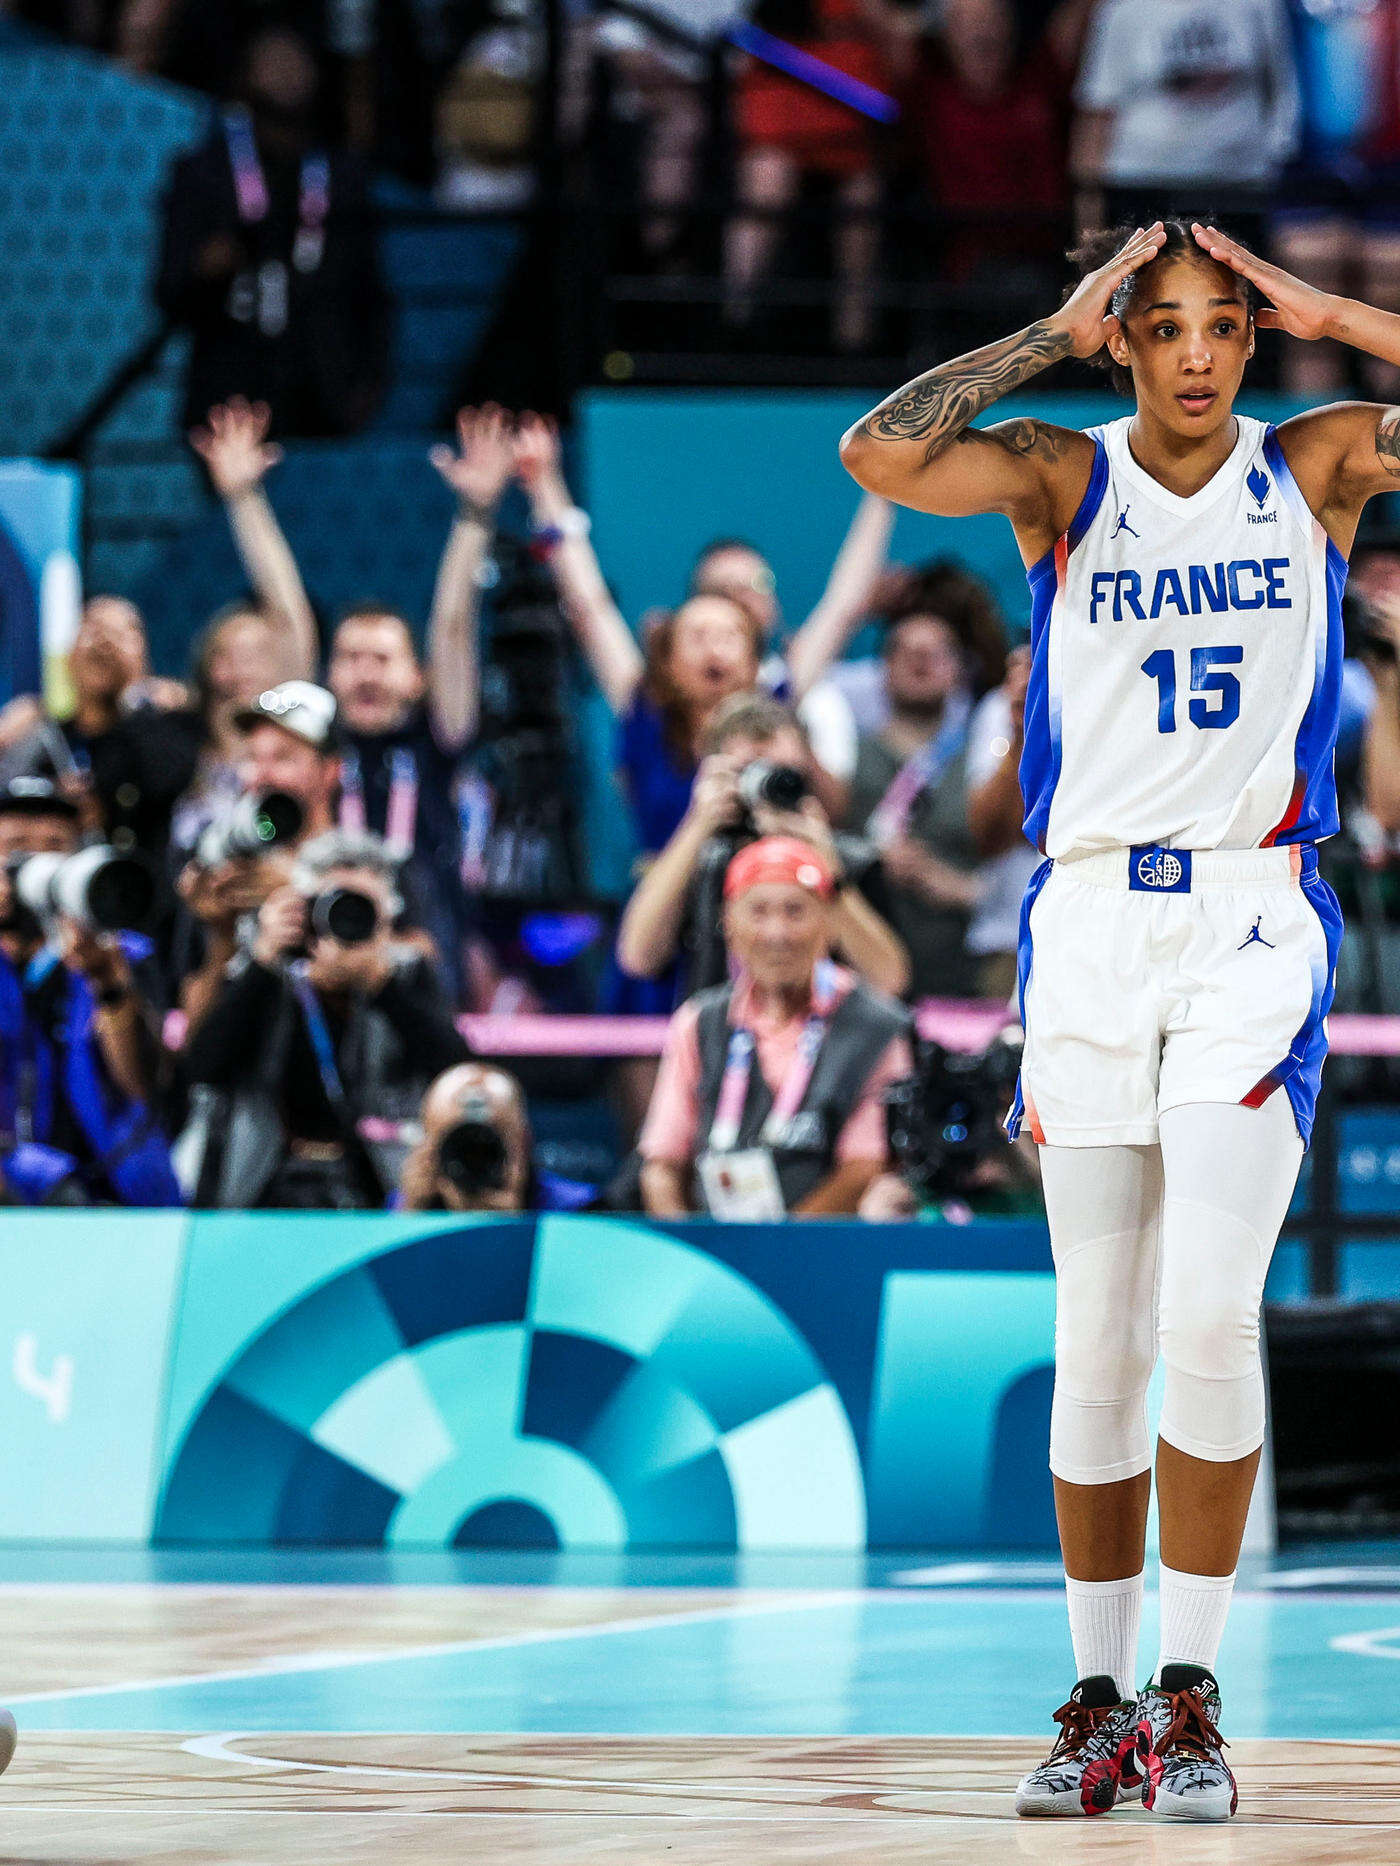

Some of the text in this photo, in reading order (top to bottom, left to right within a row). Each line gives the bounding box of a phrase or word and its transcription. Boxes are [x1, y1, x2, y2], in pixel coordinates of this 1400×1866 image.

[1246, 510, 1278, 524] FRANCE
[1090, 557, 1292, 624] FRANCE
[1141, 645, 1243, 733] 15
[12, 1332, 76, 1423] 4
